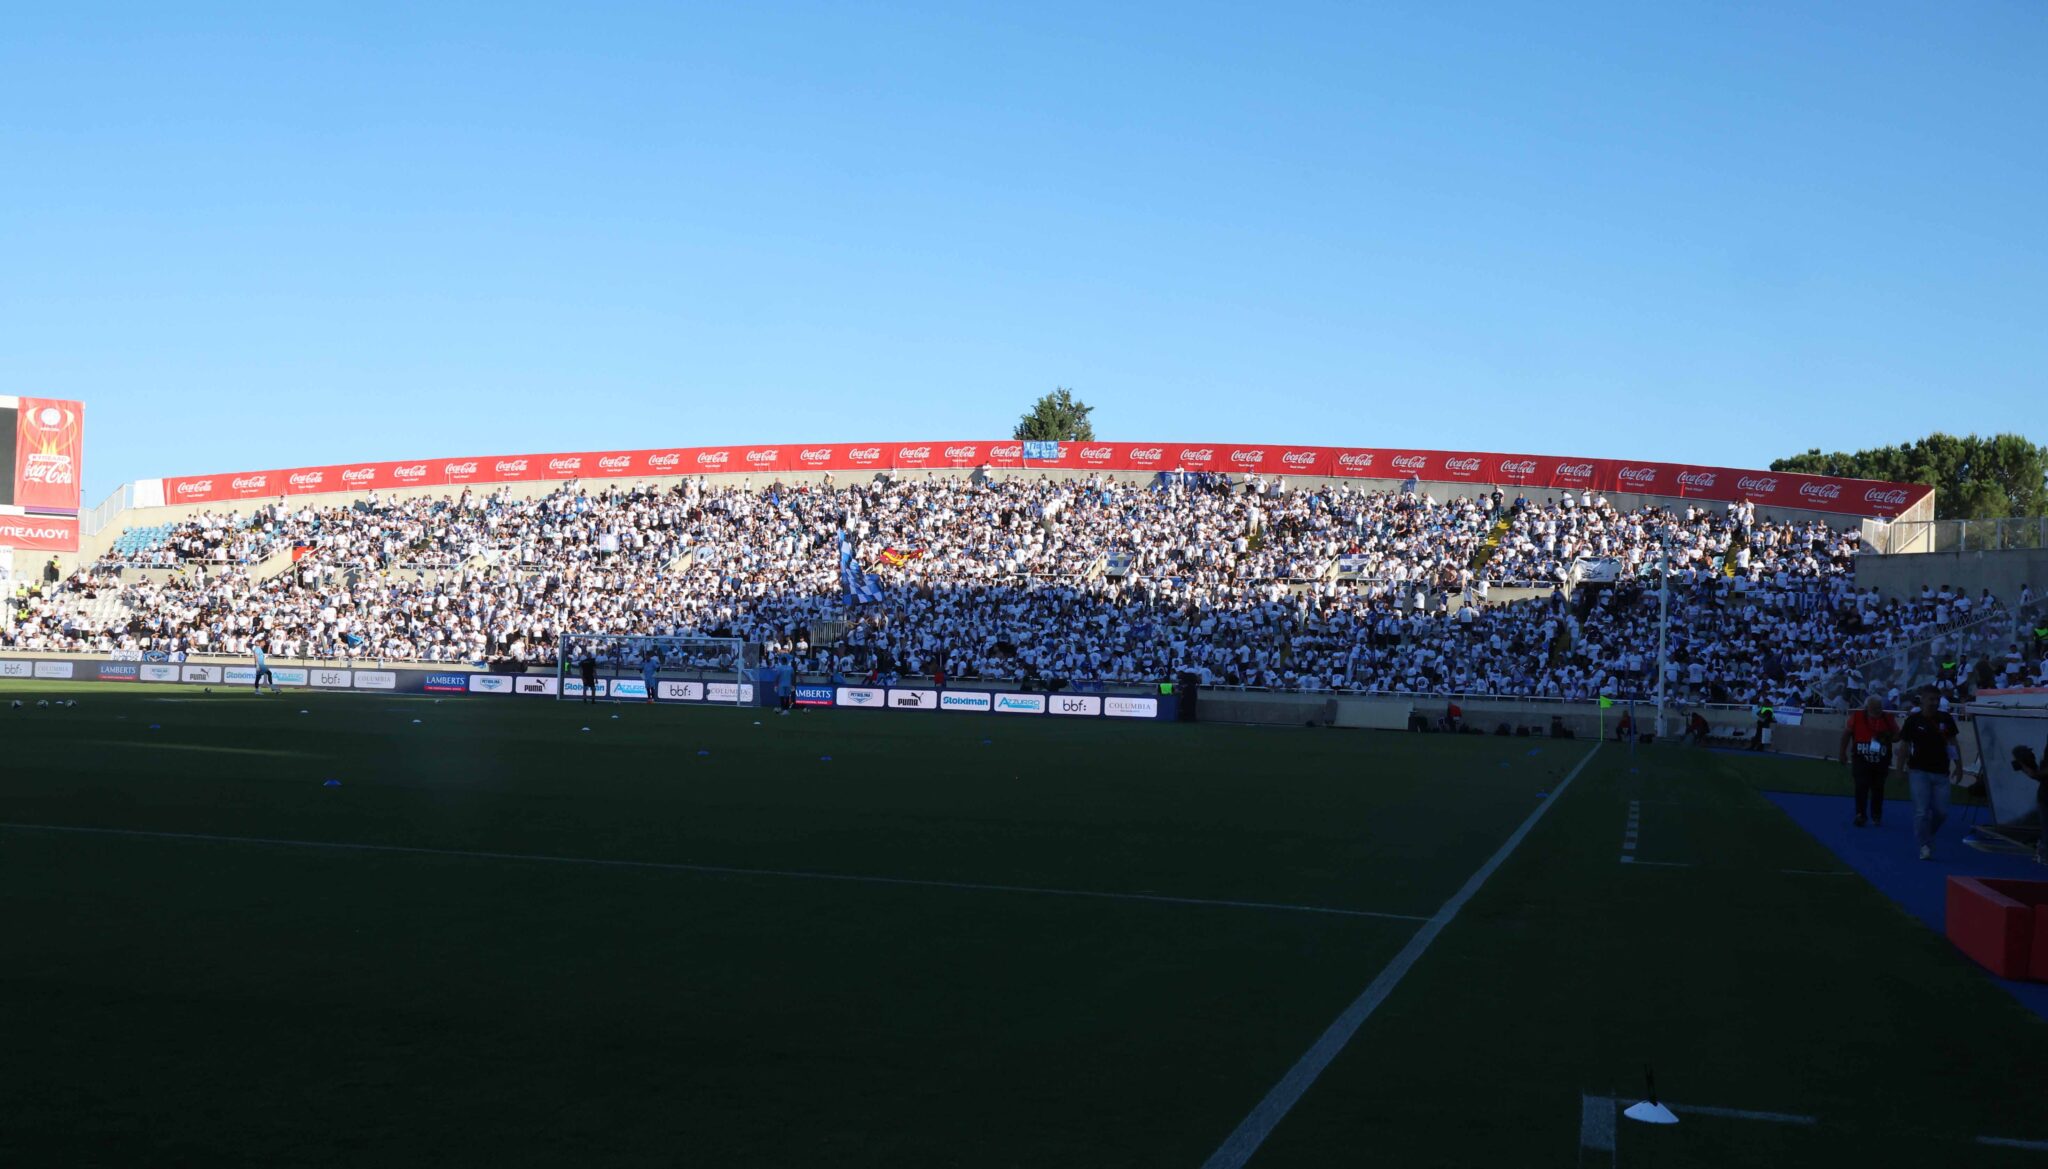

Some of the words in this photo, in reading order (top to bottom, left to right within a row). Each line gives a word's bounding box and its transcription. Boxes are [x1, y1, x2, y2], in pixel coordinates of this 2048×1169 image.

[101, 665, 136, 674] LAMBERTS
[321, 673, 341, 684] bbf:
[426, 676, 465, 685] LAMBERTS
[524, 684, 543, 692] PUMA
[670, 684, 691, 696] bbf:
[796, 689, 831, 698] MBERTS
[898, 698, 918, 707] PUMA
[943, 696, 988, 706] Stoiximan
[1063, 699, 1086, 711] bbf:
[1109, 702, 1151, 710] COLUMBIA
[1857, 743, 1887, 756] PHO
